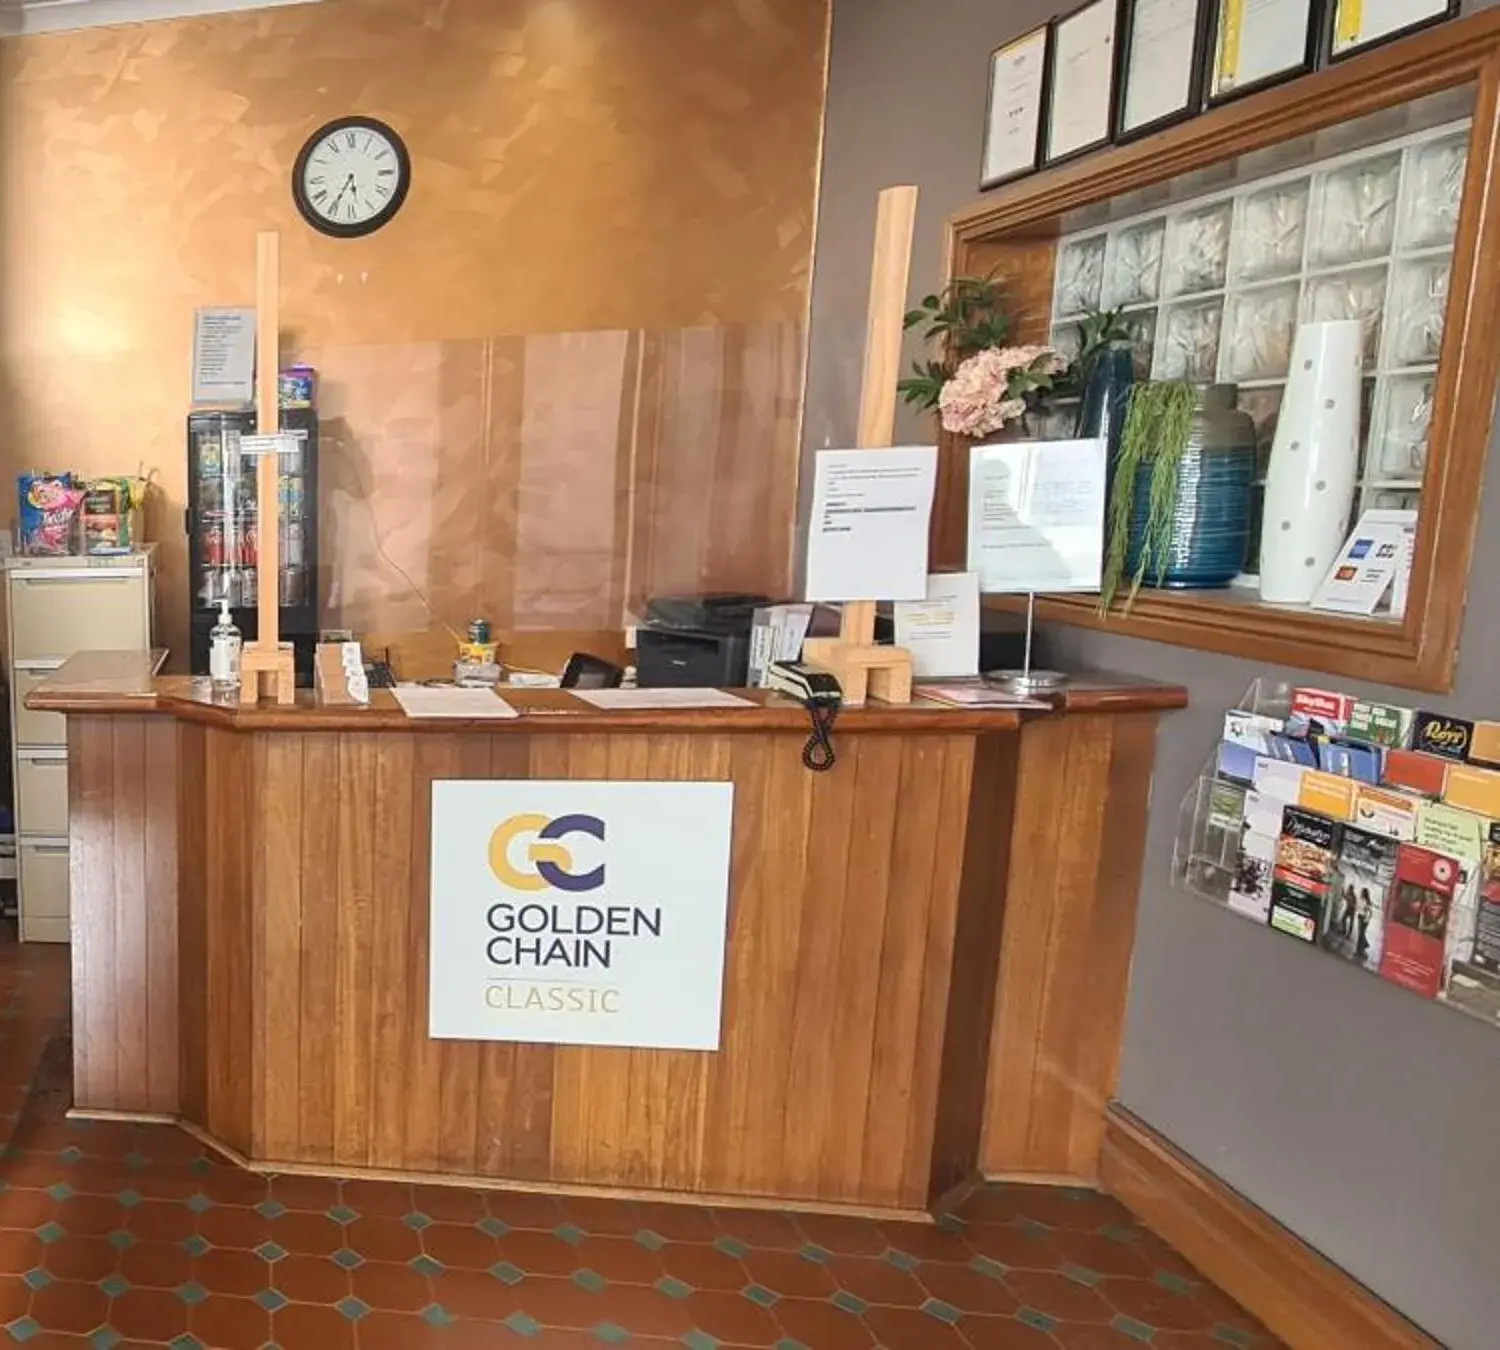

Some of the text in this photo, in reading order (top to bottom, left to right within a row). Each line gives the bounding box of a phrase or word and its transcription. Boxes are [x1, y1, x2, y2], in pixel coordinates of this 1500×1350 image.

[486, 903, 661, 937] GOLDEN
[486, 936, 611, 968] CHAIN
[485, 985, 620, 1014] CLASSIC
